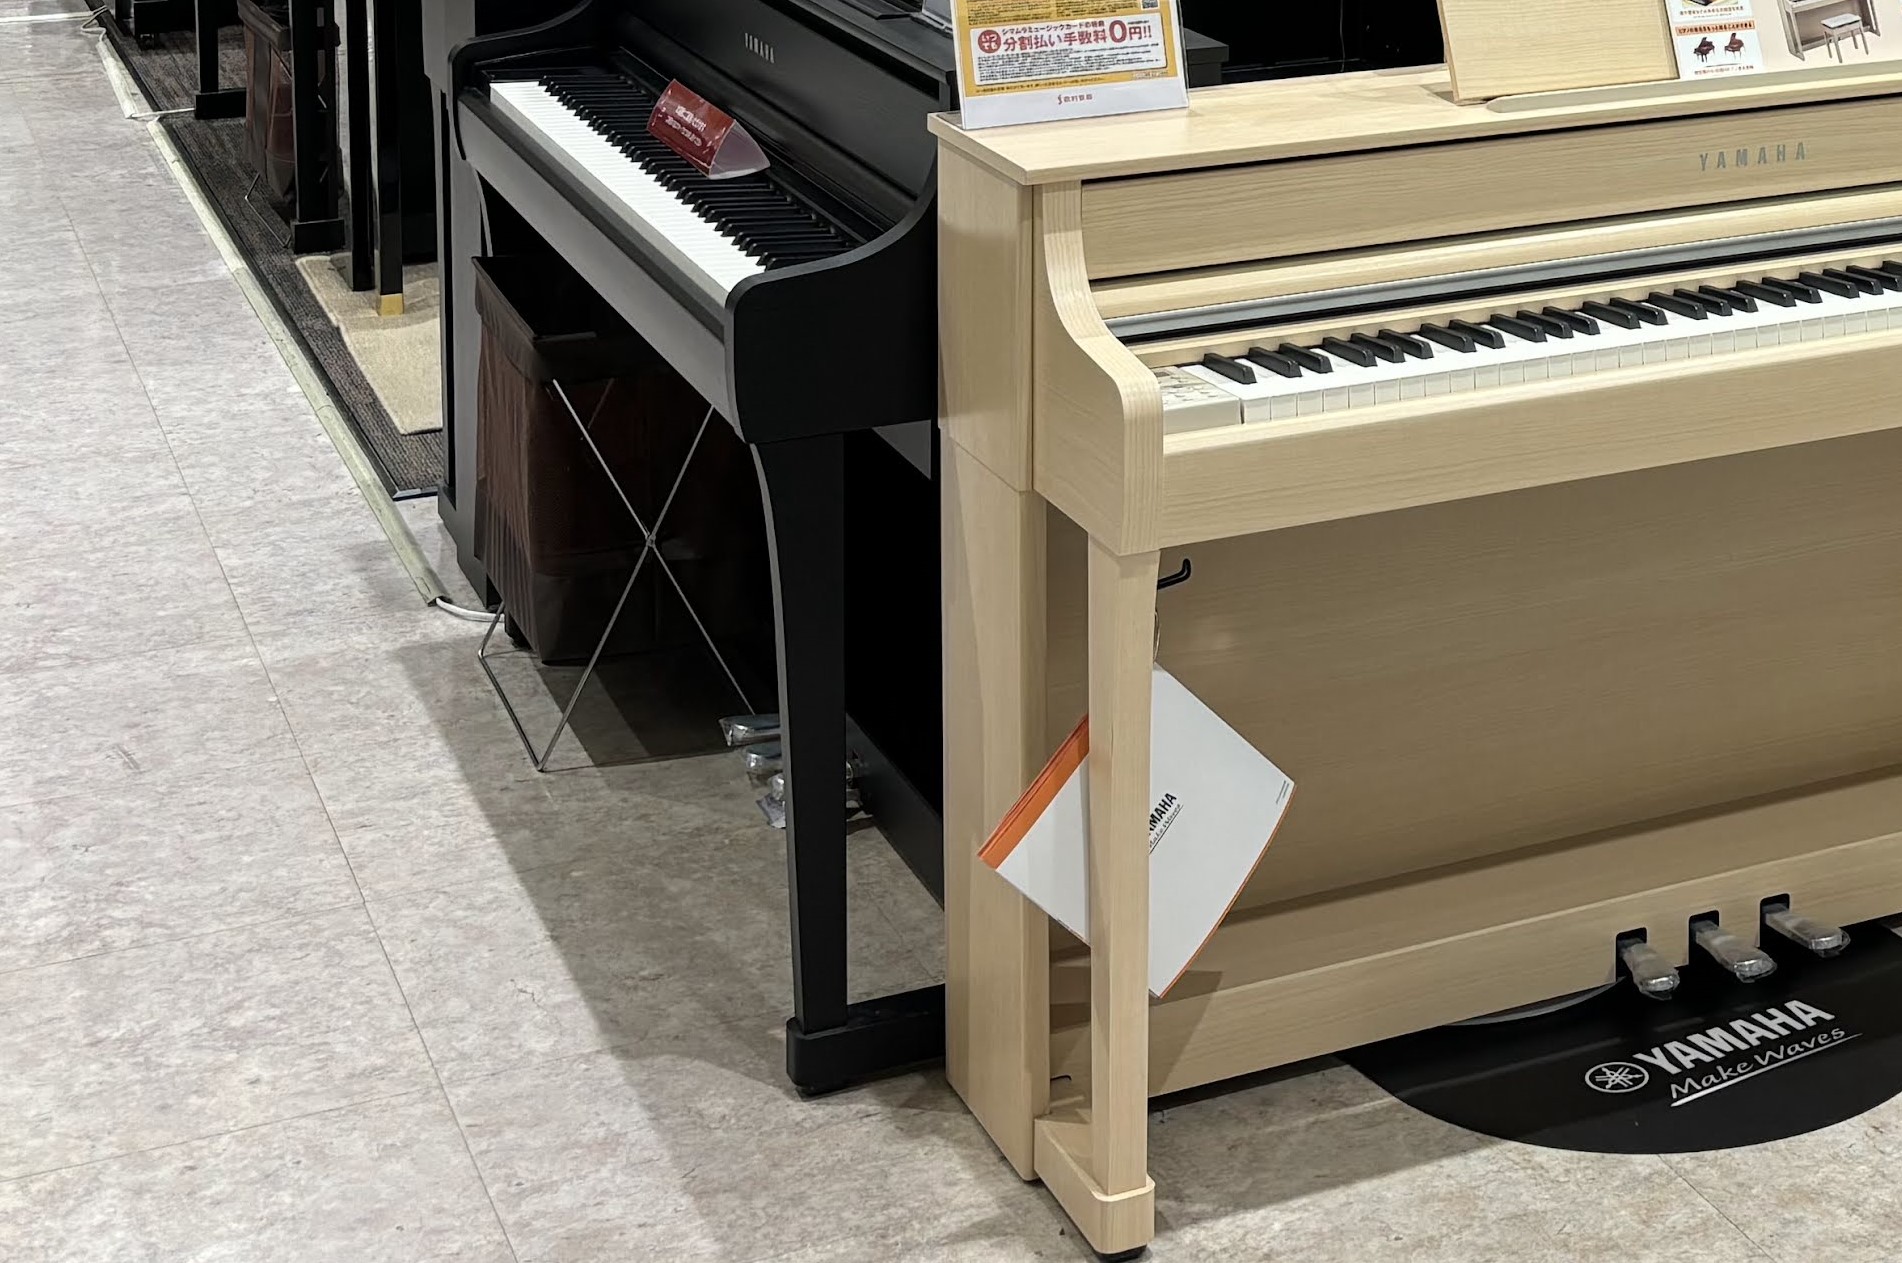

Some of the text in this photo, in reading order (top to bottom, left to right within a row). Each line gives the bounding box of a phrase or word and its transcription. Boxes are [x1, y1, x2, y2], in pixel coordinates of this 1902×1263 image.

[1700, 141, 1805, 171] YAMAHA
[1633, 999, 1836, 1075] YAMAHA
[1670, 1025, 1846, 1100] Make Waves
